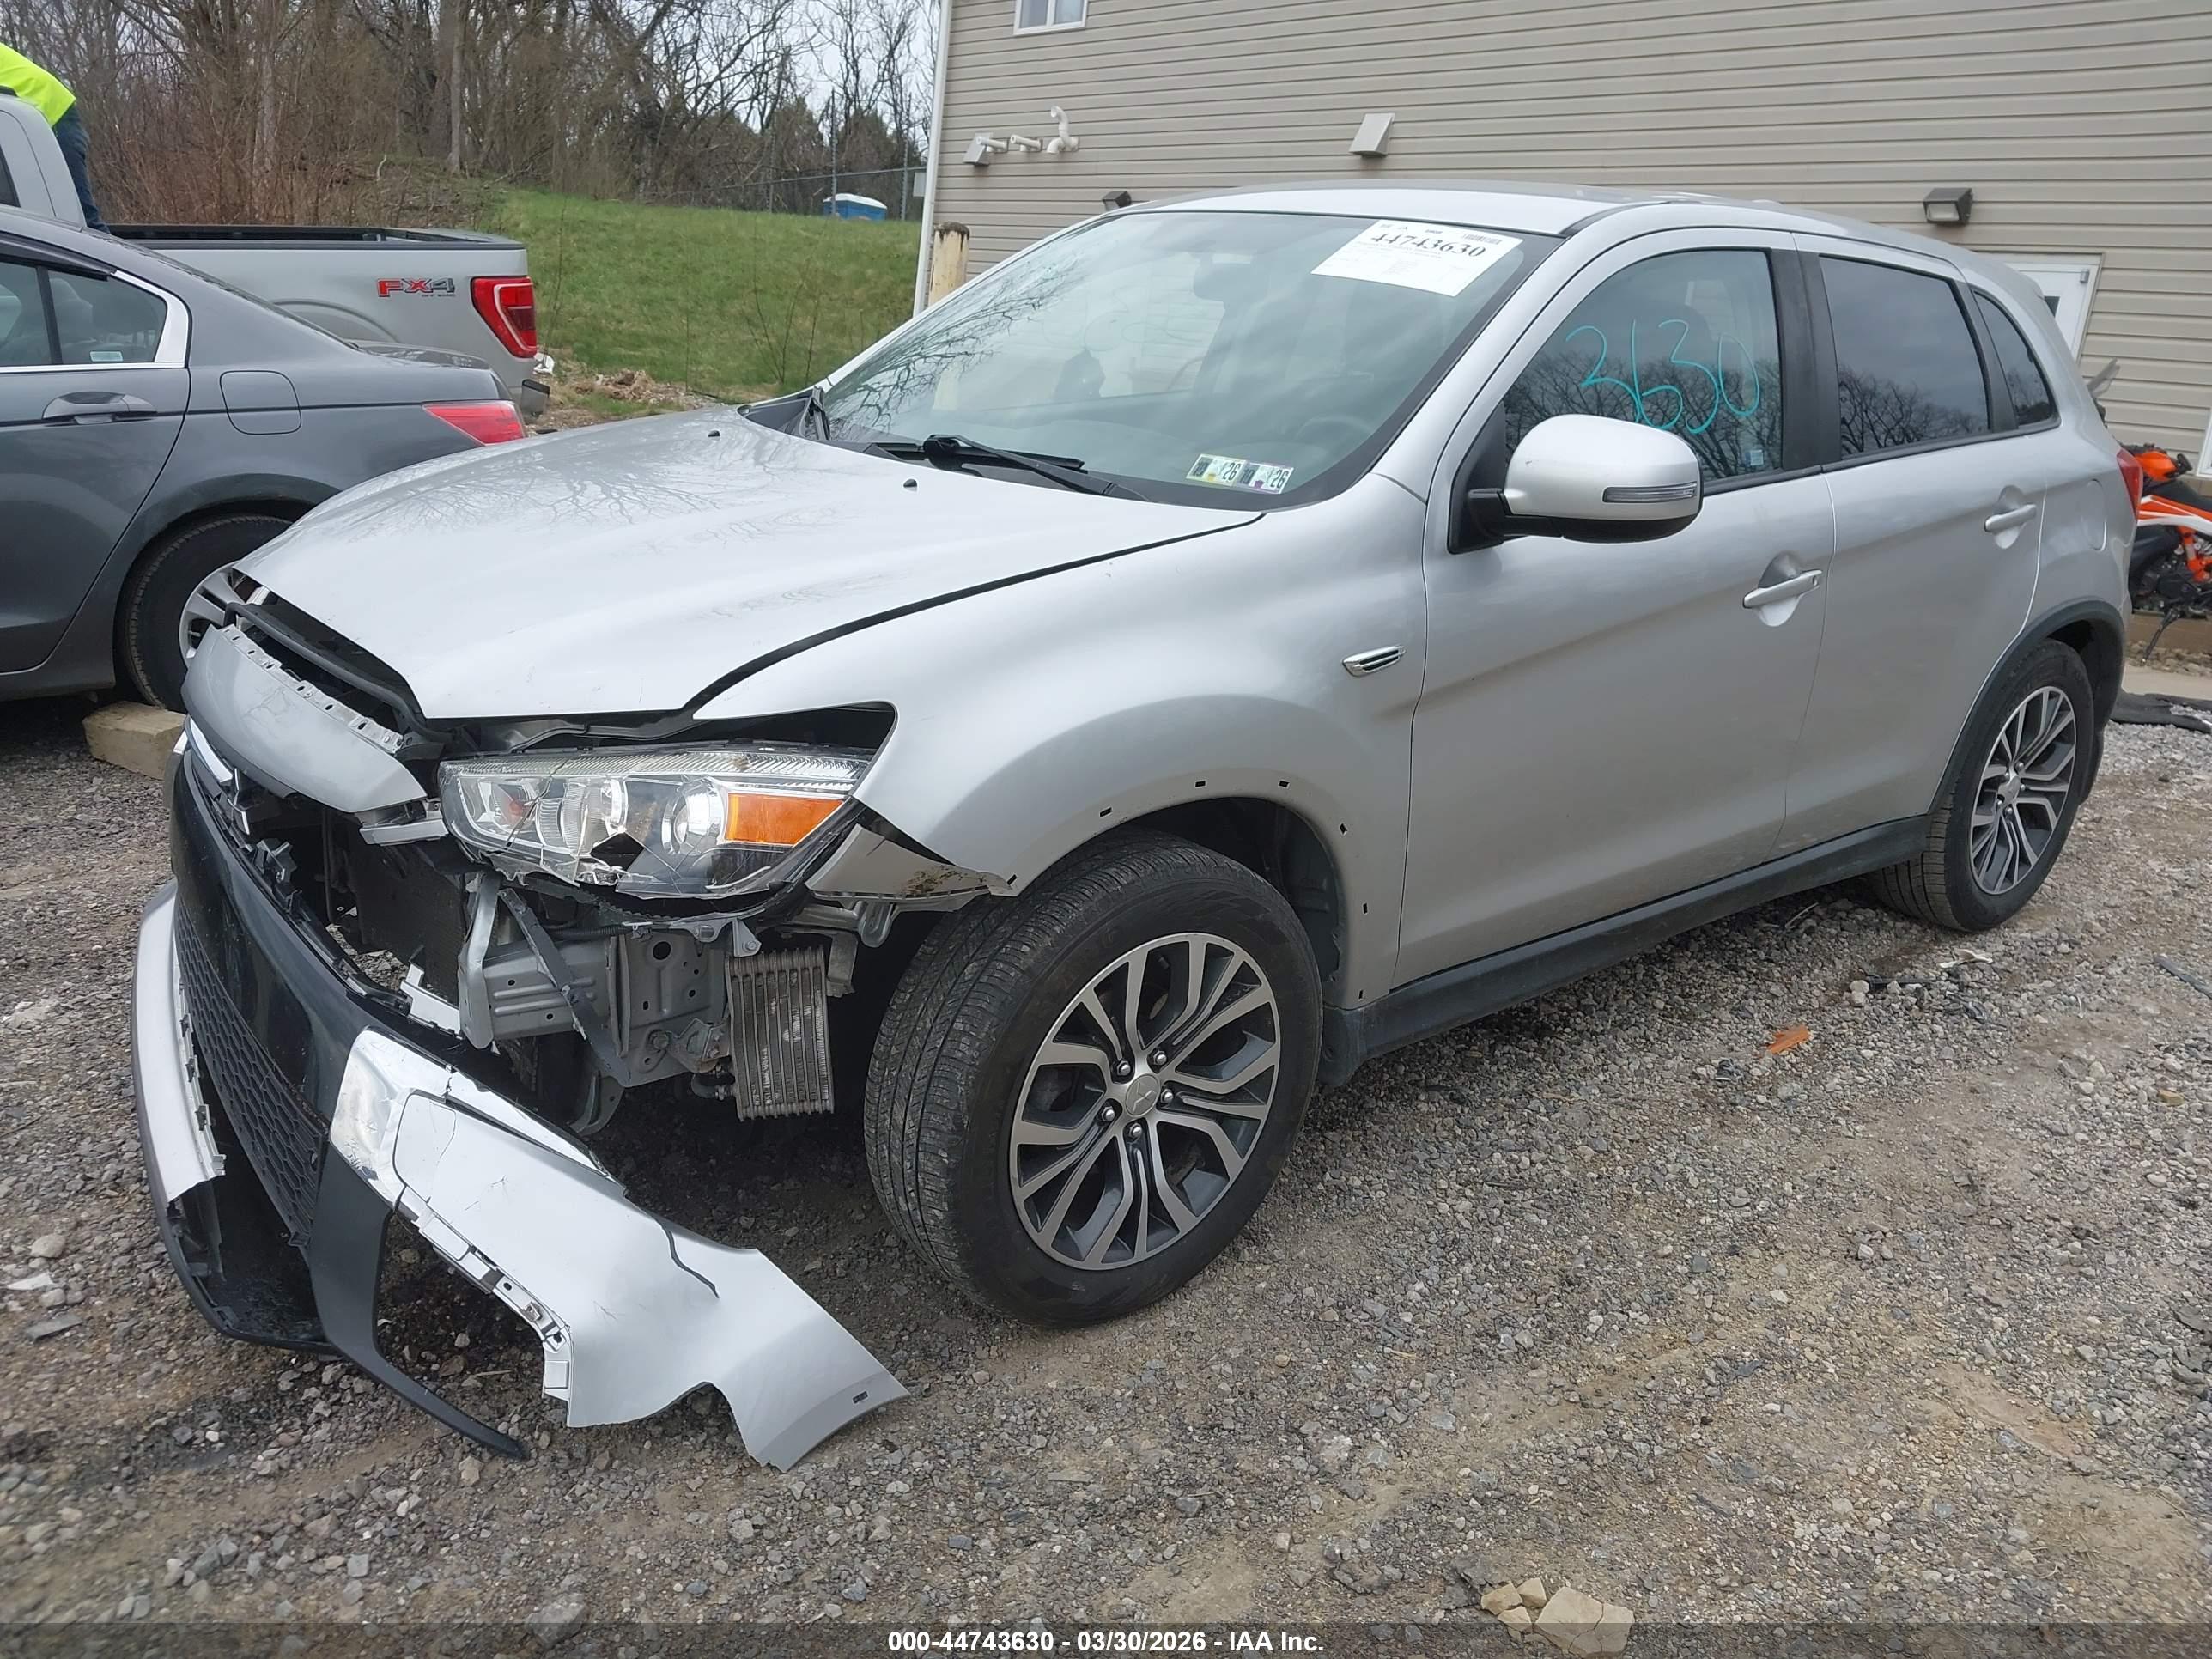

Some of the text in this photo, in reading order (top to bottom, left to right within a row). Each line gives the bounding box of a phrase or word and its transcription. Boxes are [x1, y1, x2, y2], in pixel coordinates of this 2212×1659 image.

[1370, 232, 1486, 258] 44743630
[378, 277, 455, 297] FX4
[1222, 462, 1242, 482] 26
[1270, 469, 1290, 489] 26
